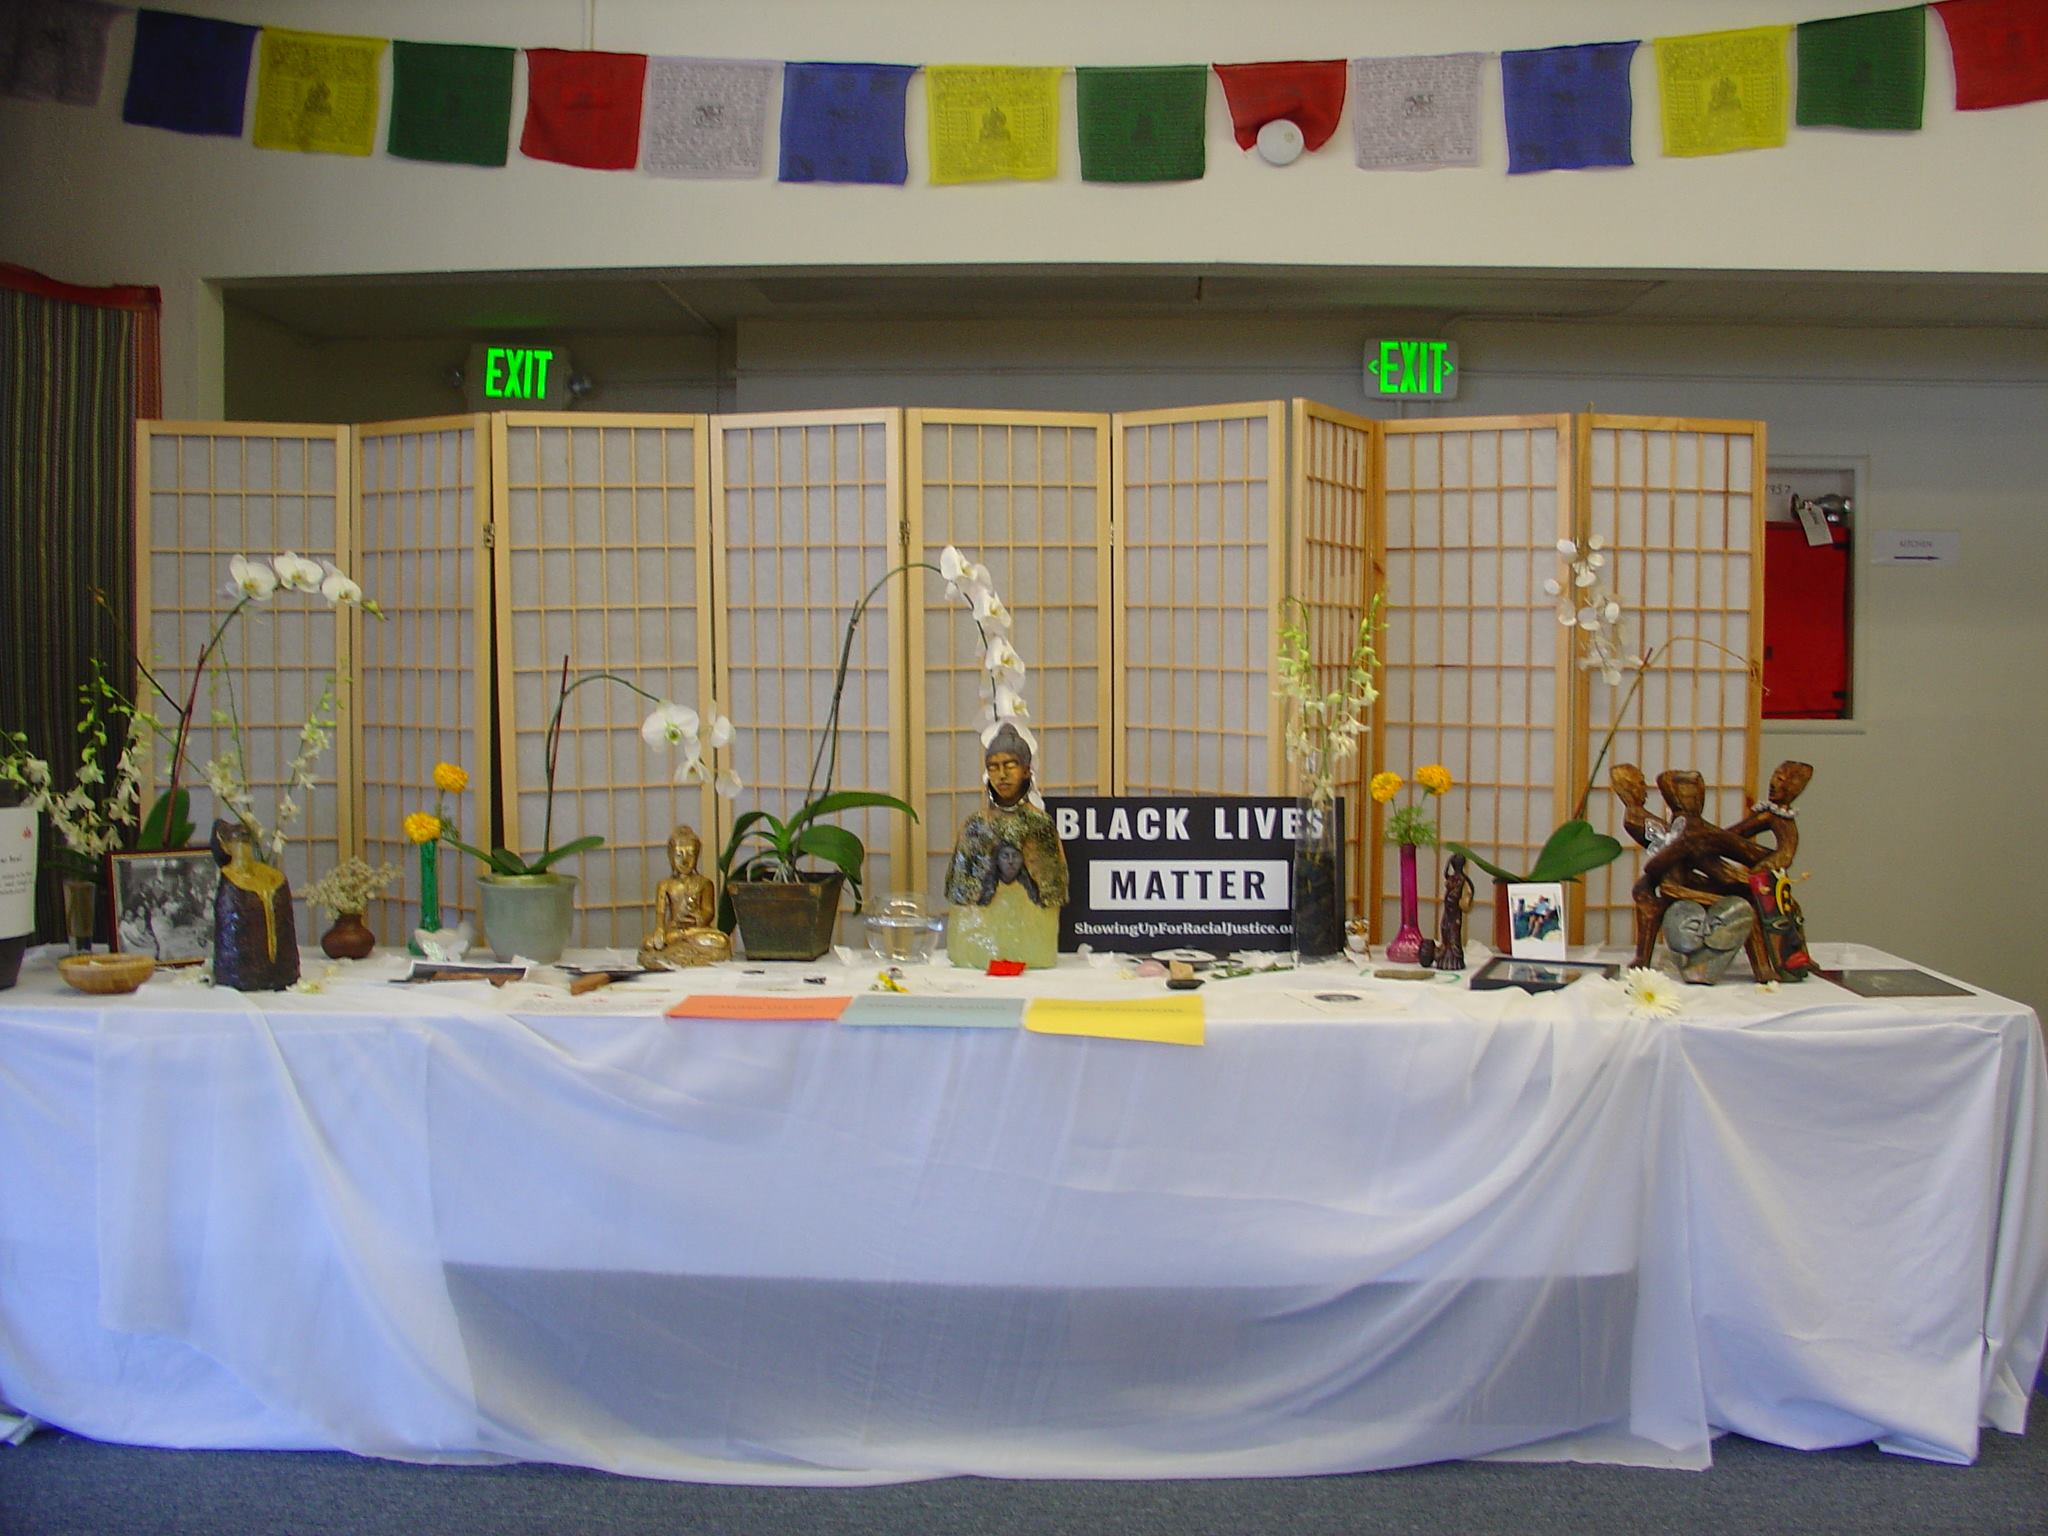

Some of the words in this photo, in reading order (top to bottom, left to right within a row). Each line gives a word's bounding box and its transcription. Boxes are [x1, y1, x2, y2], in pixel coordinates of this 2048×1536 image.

[485, 347, 553, 399] EXIT
[1380, 341, 1447, 394] EXIT
[1056, 807, 1190, 840] BLACK
[1215, 807, 1325, 840] LIVES
[1110, 870, 1266, 901] MATTER
